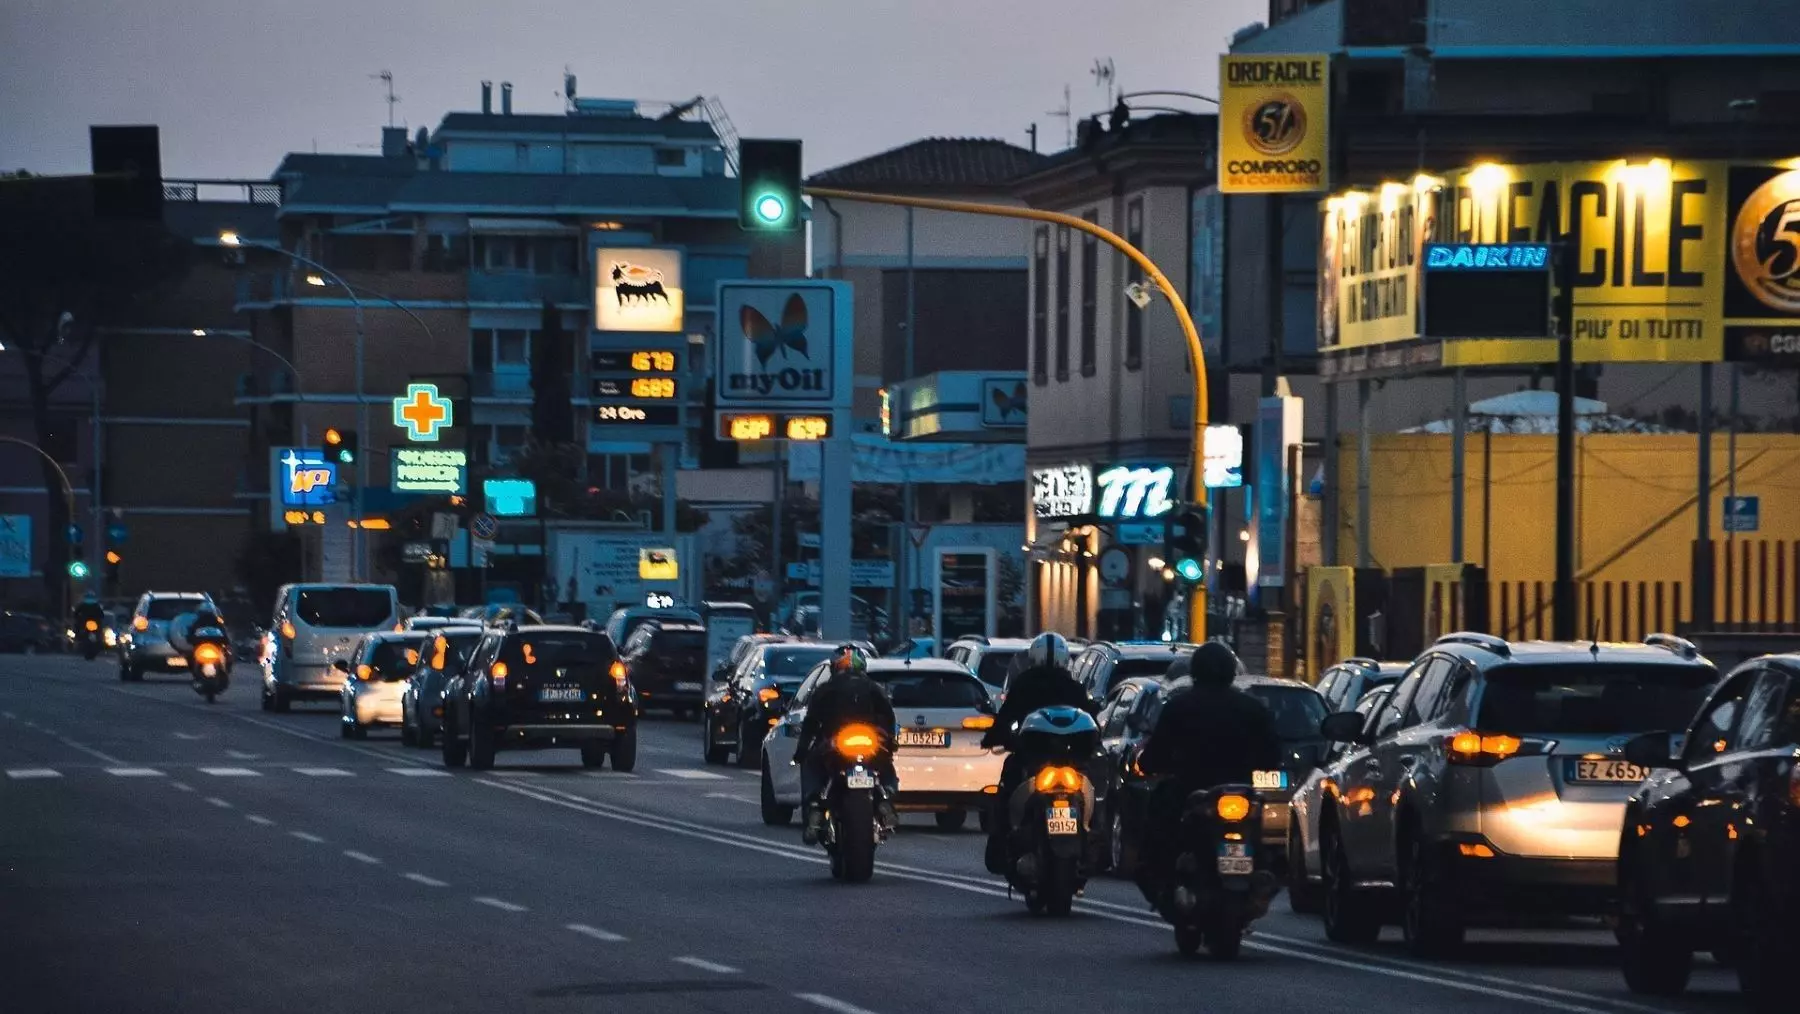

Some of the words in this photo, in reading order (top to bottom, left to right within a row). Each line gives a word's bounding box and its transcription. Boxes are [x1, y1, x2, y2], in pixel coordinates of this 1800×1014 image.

[1228, 62, 1322, 81] OROFACILE
[1427, 246, 1548, 268] DAIKIN
[730, 367, 826, 395] myOil
[1577, 762, 1599, 779] EZ
[1049, 821, 1077, 832] 99152
